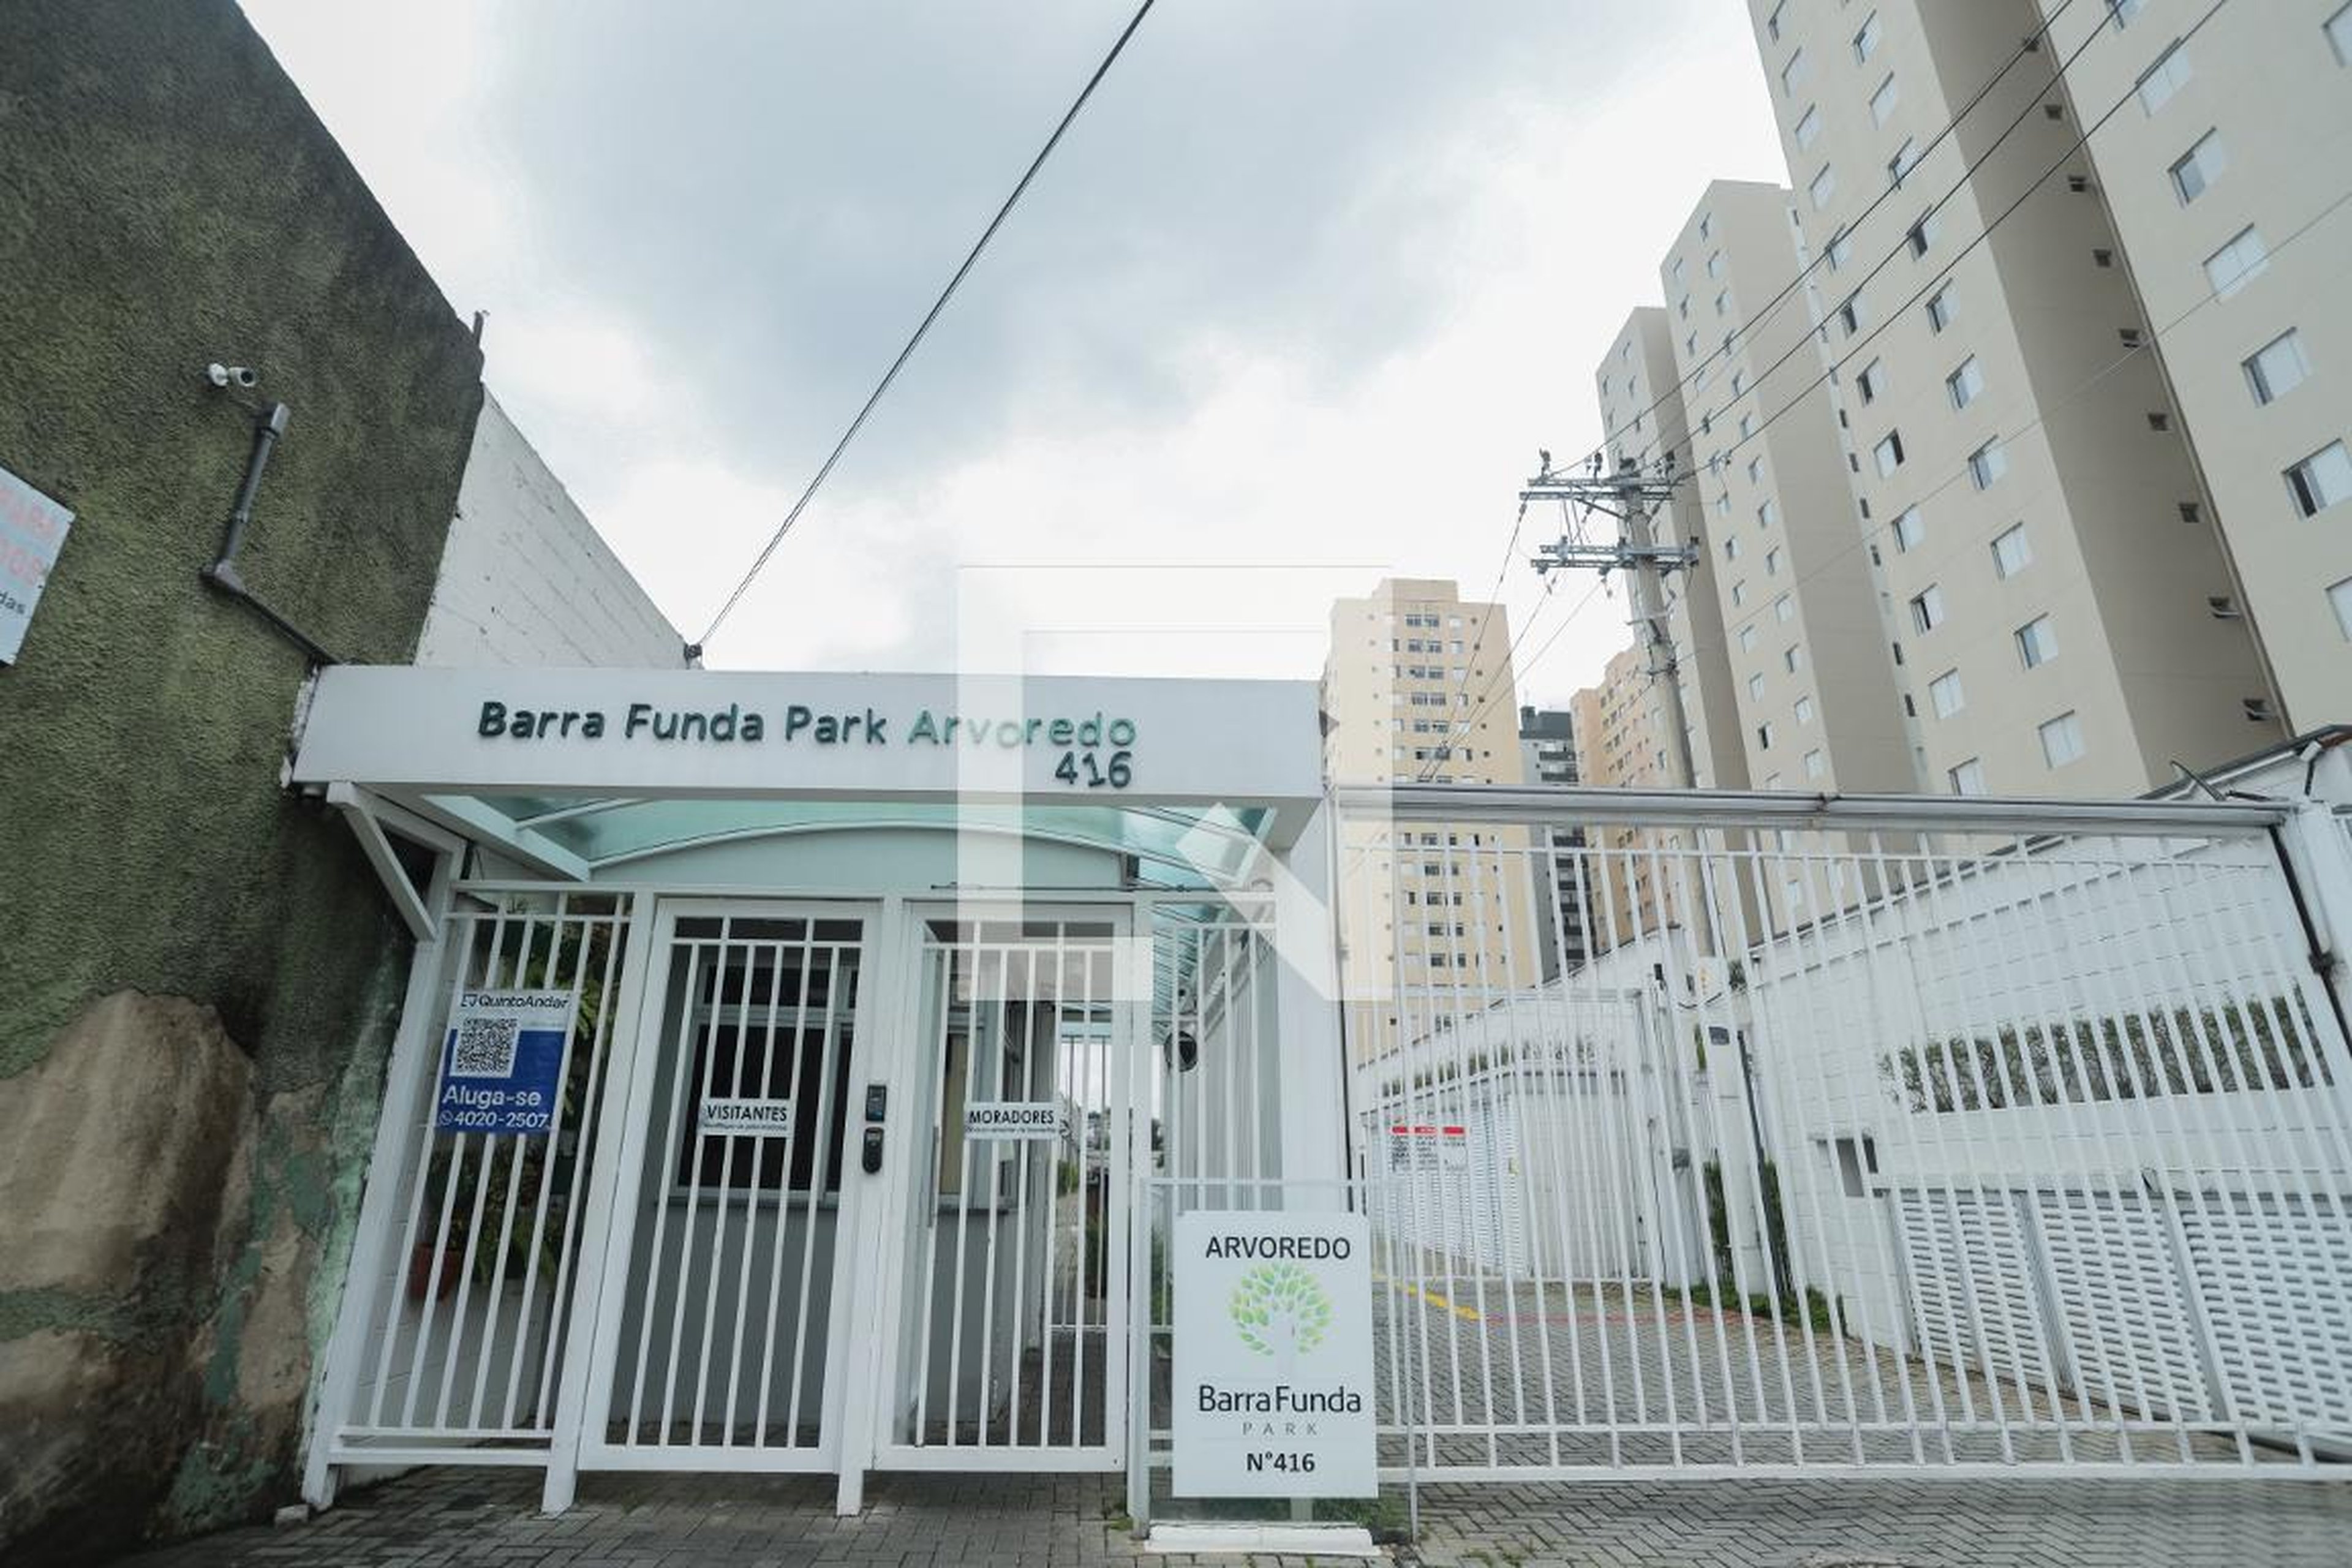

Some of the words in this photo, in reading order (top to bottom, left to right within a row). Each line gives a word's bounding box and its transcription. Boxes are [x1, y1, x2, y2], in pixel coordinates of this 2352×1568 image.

[478, 701, 605, 739] Barra
[625, 703, 764, 742] Funda
[785, 706, 887, 745] Park
[908, 709, 1136, 749] Arvoredo
[1055, 751, 1132, 788] 416
[479, 994, 568, 1009] QuintoAndar
[442, 1084, 542, 1110] Aluga-se
[454, 1111, 549, 1128] 4020-2507
[707, 1105, 787, 1121] VISITANTES
[969, 1110, 1055, 1125] MORADORES
[1205, 1237, 1351, 1260] ARVOREDO
[1243, 1422, 1317, 1436] PARK
